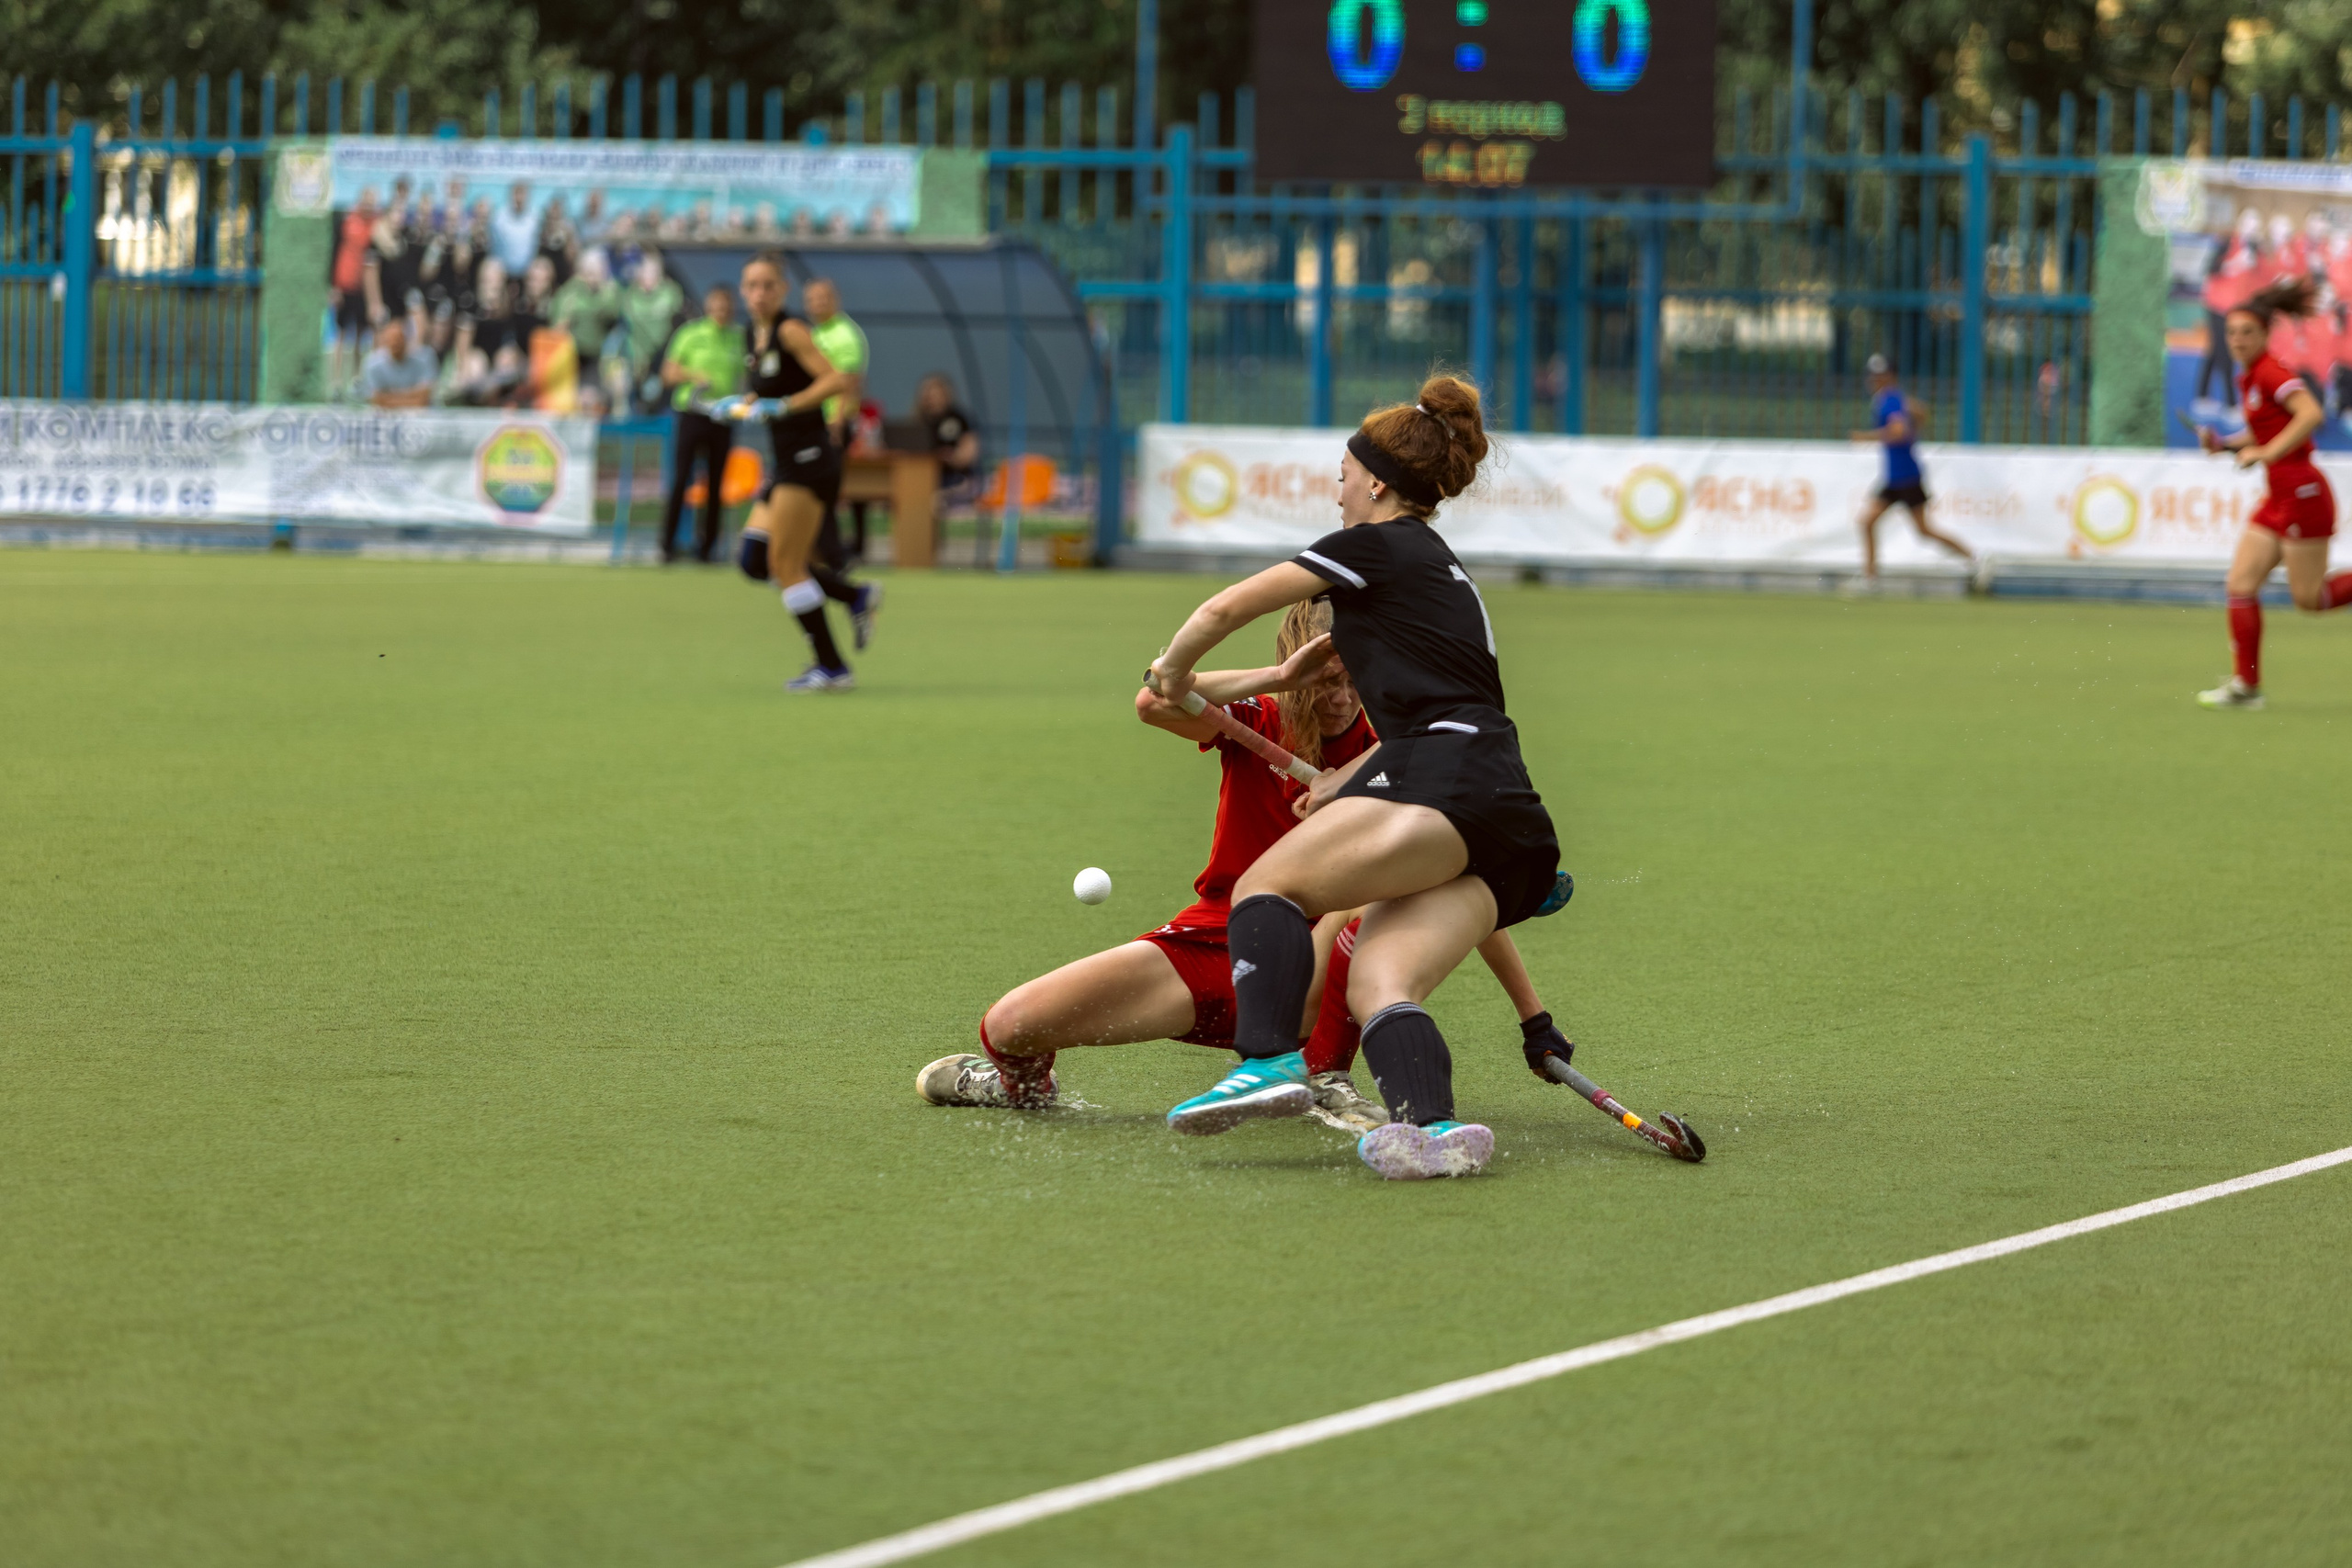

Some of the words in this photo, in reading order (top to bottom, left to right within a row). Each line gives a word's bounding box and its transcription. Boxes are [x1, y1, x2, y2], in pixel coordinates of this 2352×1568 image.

[1328, 0, 1406, 91] 0
[1572, 0, 1651, 92] 0
[1269, 763, 1289, 782] adidas
